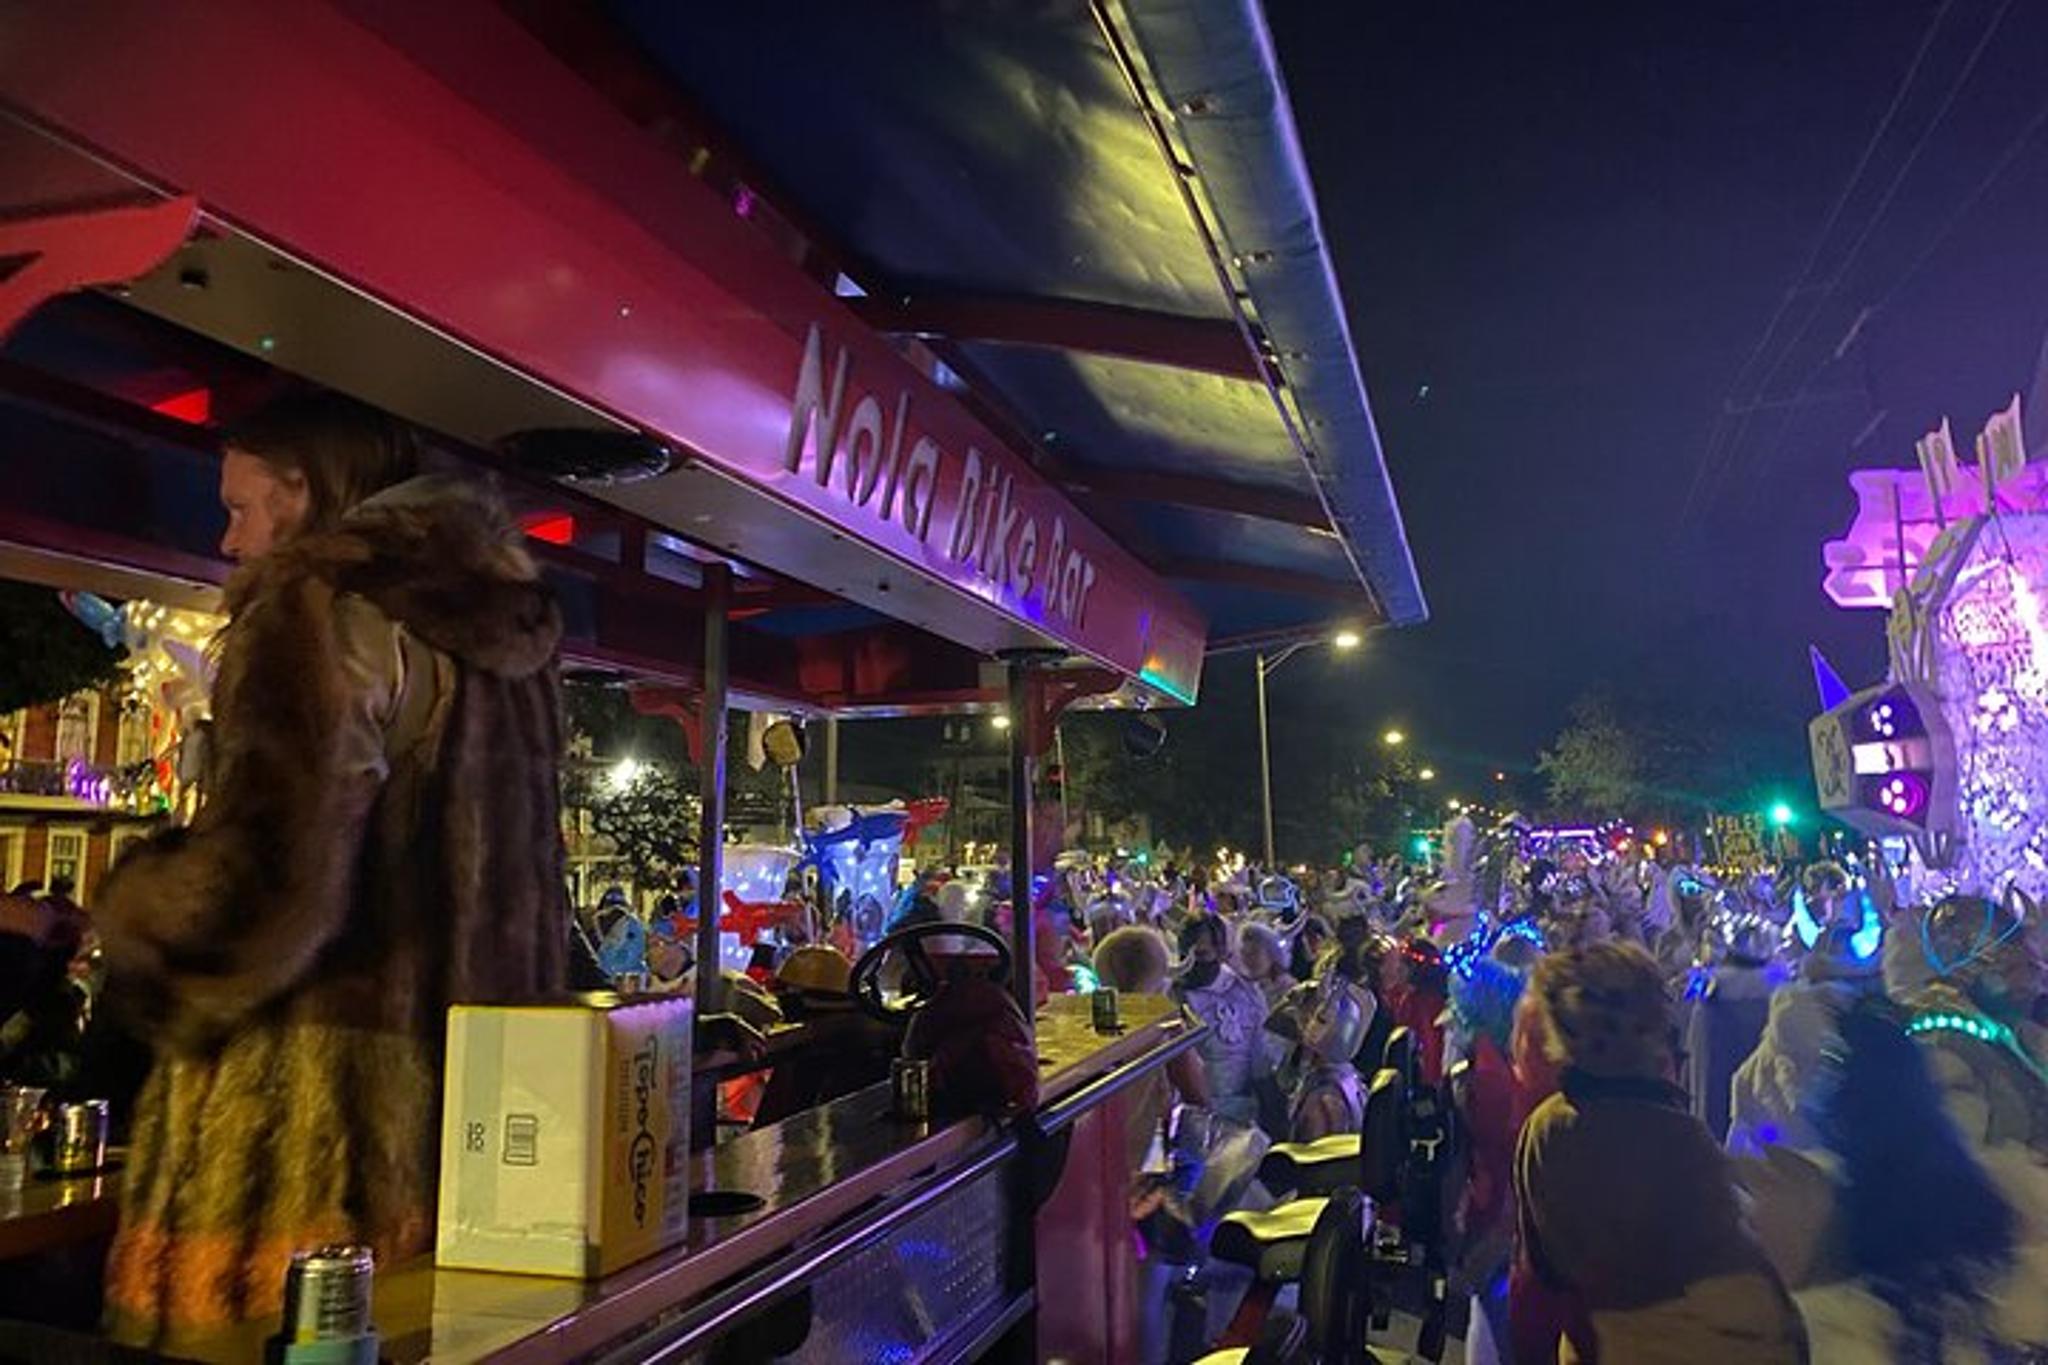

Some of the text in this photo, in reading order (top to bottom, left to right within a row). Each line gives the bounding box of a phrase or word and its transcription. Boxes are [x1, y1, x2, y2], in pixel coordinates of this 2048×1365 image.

[787, 322, 1095, 630] Nola Bike Bar
[629, 1034, 659, 1228] Topo Chico
